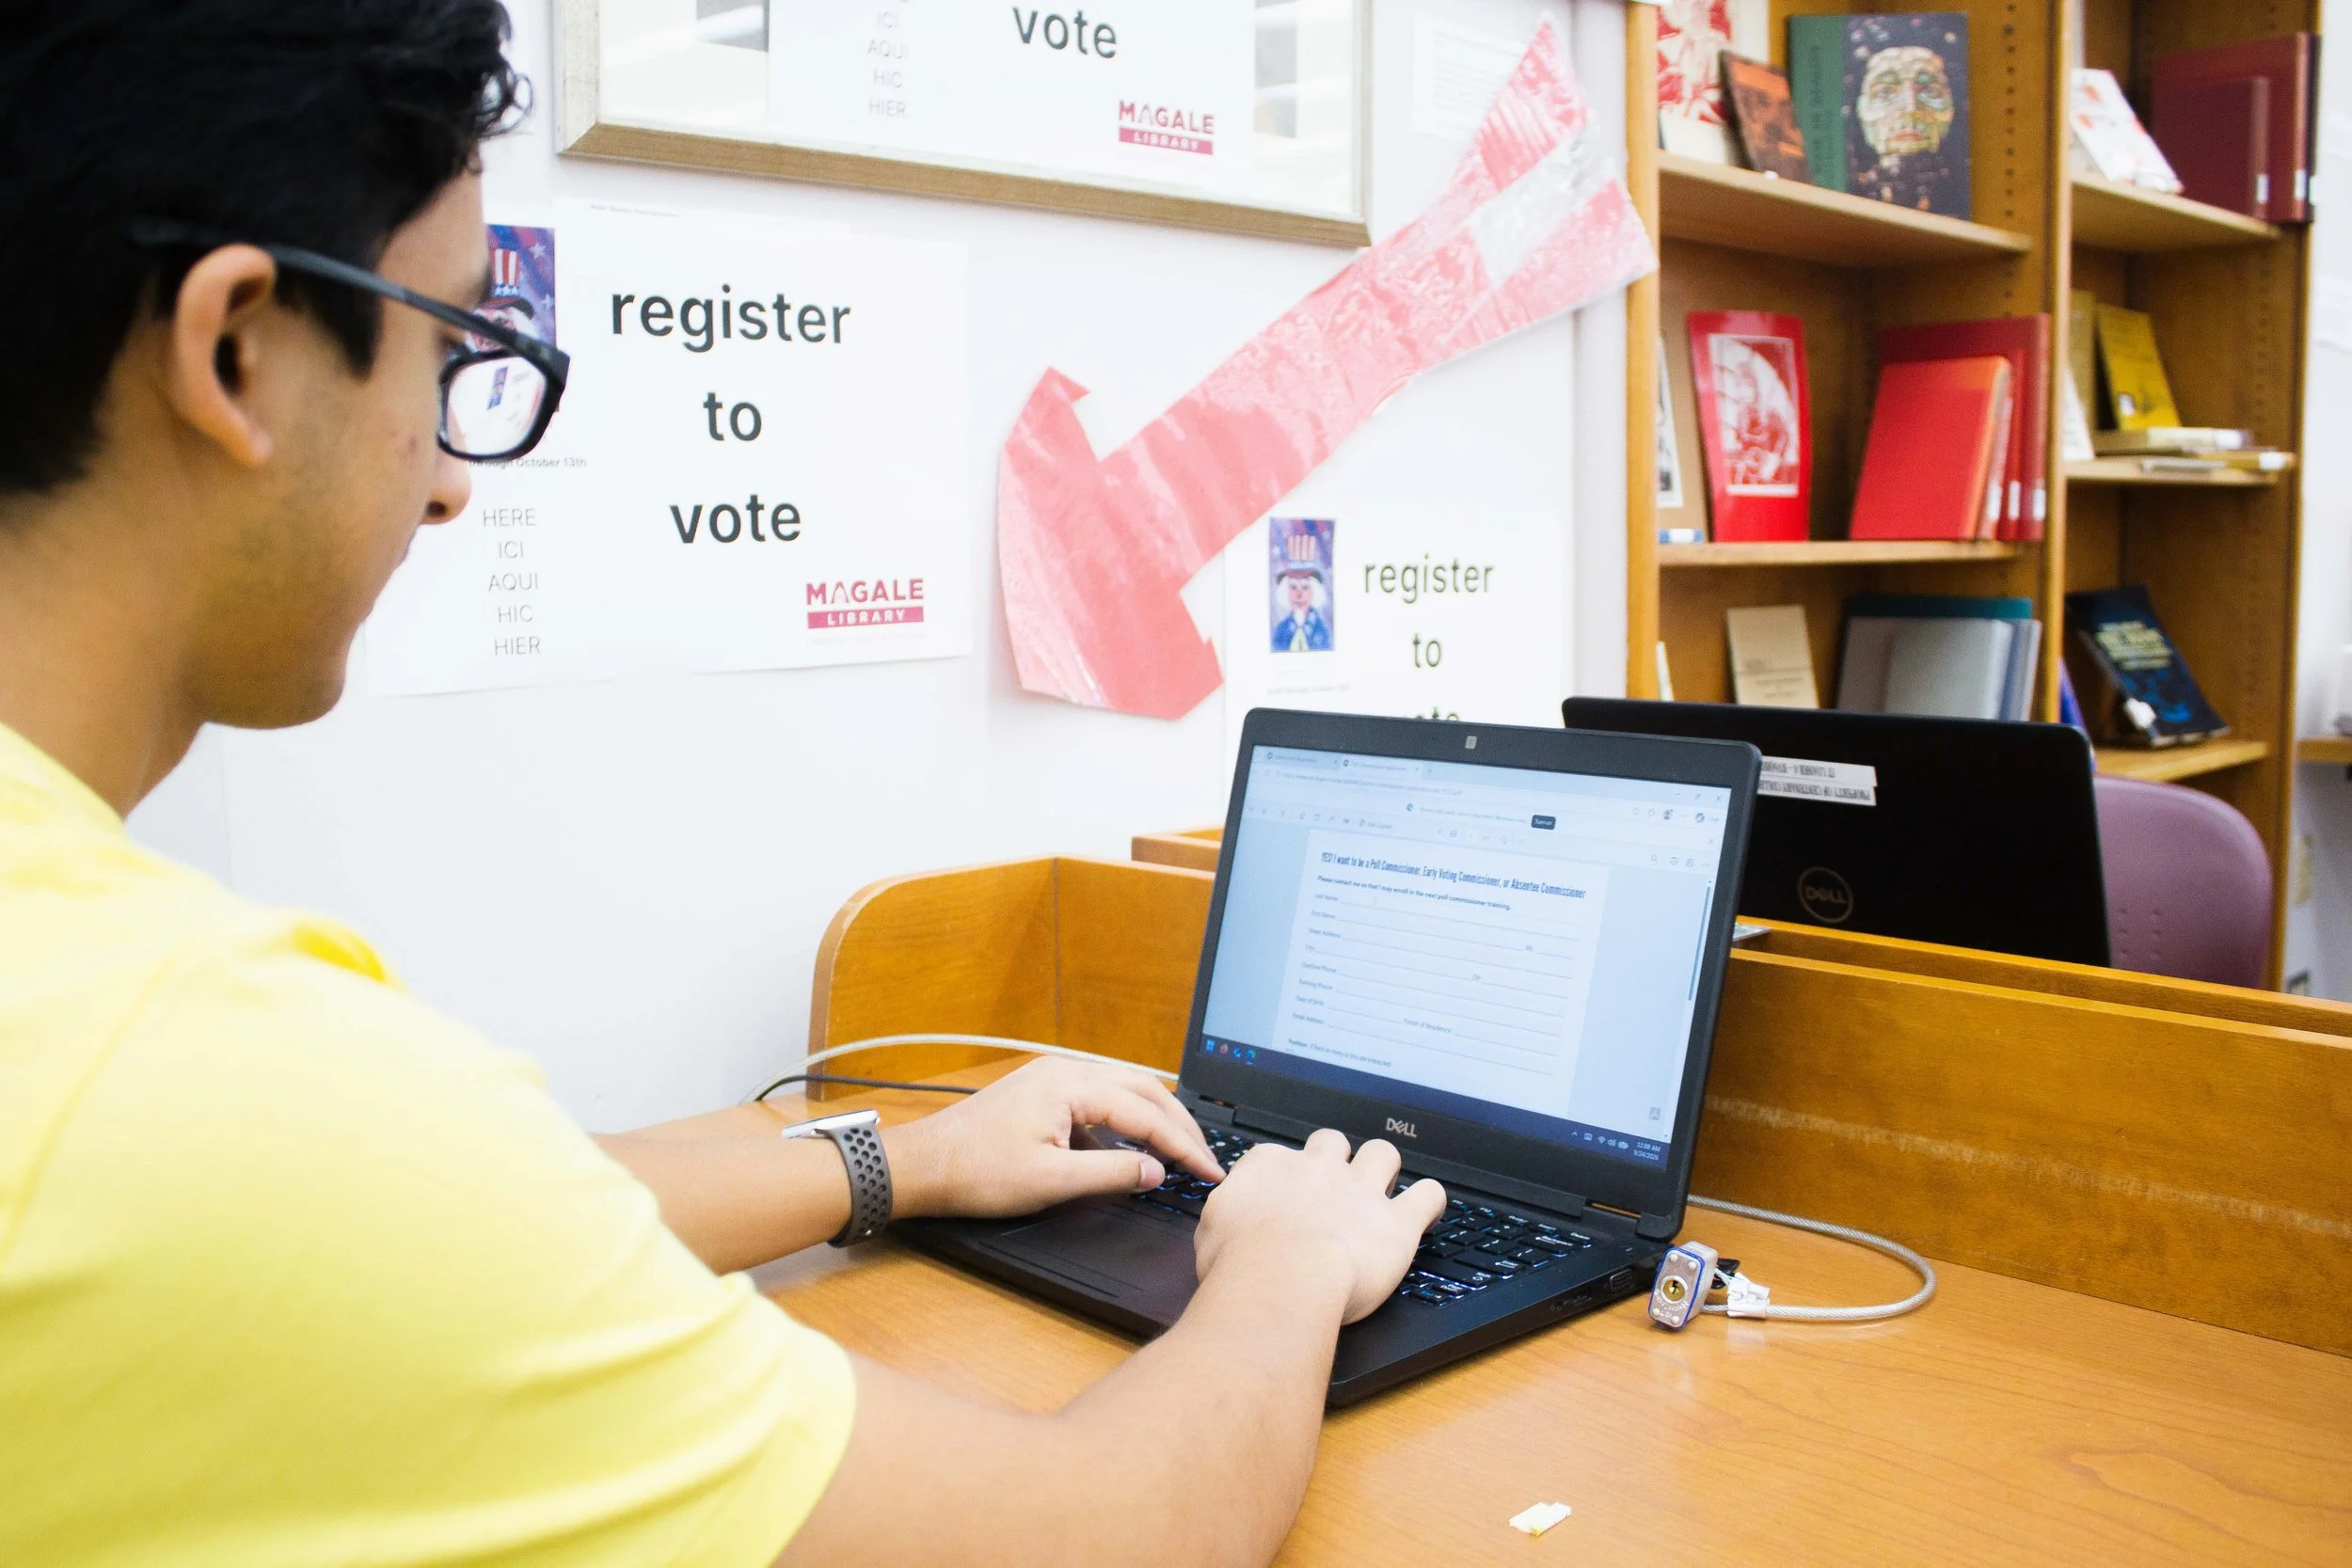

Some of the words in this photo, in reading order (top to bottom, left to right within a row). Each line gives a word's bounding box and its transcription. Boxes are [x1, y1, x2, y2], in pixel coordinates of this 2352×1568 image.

[1013, 7, 1117, 59] vote
[867, 40, 908, 60] AQUI
[873, 70, 903, 89] HIC
[868, 97, 906, 119] HIER
[1119, 100, 1215, 135] MAGALE
[1134, 132, 1200, 150] LIBRARY
[612, 284, 851, 353] register
[703, 392, 763, 442] to
[483, 508, 536, 527] HERE
[669, 494, 802, 544] vote
[499, 541, 524, 559] ICI
[488, 572, 539, 592] AQUI
[1364, 554, 1494, 604] register
[806, 578, 924, 605] MAGALE
[498, 605, 533, 623] HIC
[828, 610, 905, 626] LIBRARY
[494, 636, 541, 656] HIER
[1412, 633, 1442, 669] to
[1371, 859, 1381, 870] Poll
[1422, 866, 1438, 879] Early
[1438, 869, 1458, 883] Voting
[1805, 886, 1848, 903] DELL
[1386, 1117, 1418, 1138] DELL
